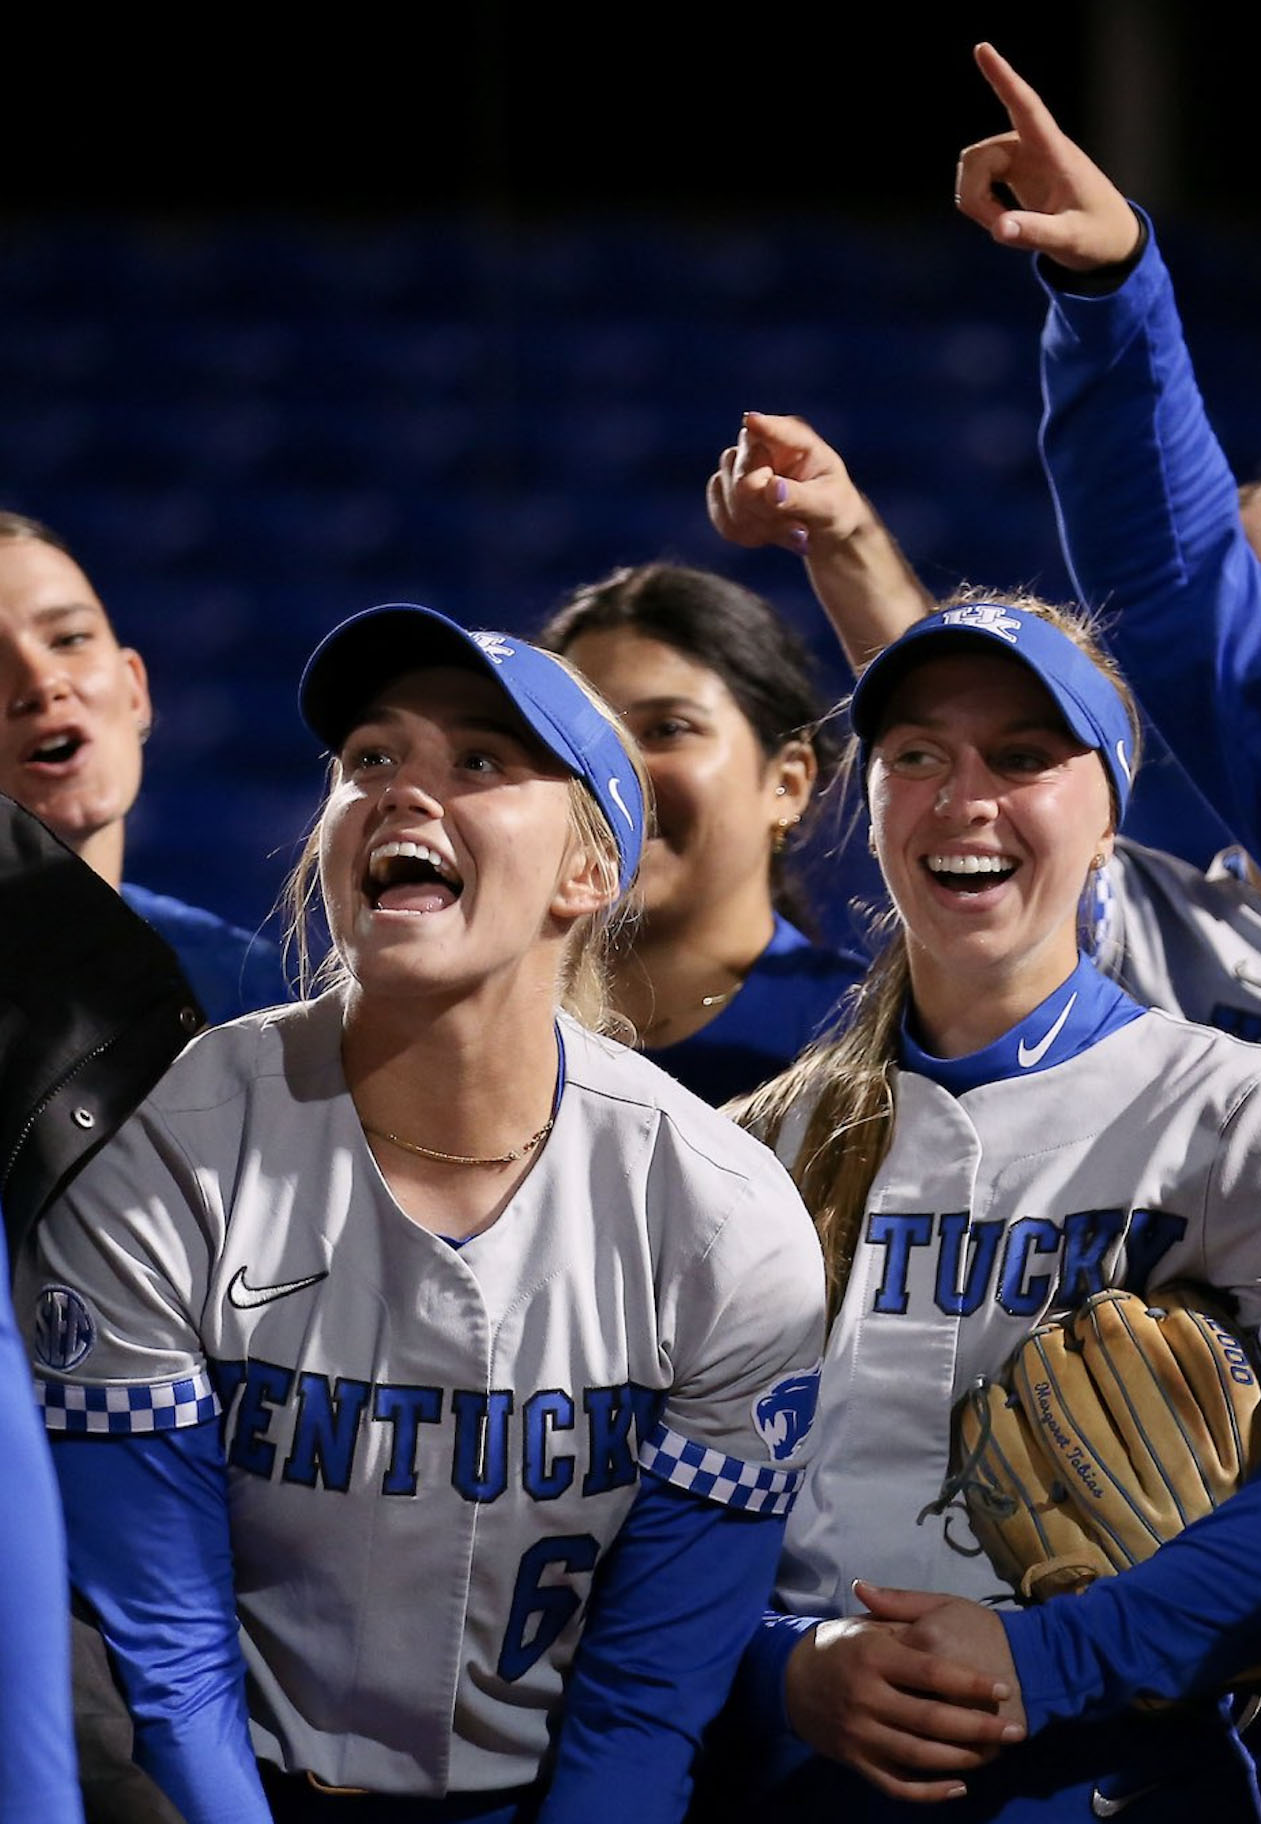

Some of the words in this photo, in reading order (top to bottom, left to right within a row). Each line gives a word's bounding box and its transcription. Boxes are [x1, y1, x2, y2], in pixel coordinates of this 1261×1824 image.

[1034, 1381, 1071, 1449] Margaret
[1066, 1446, 1105, 1499] Tobias
[497, 1533, 602, 1684] 6
